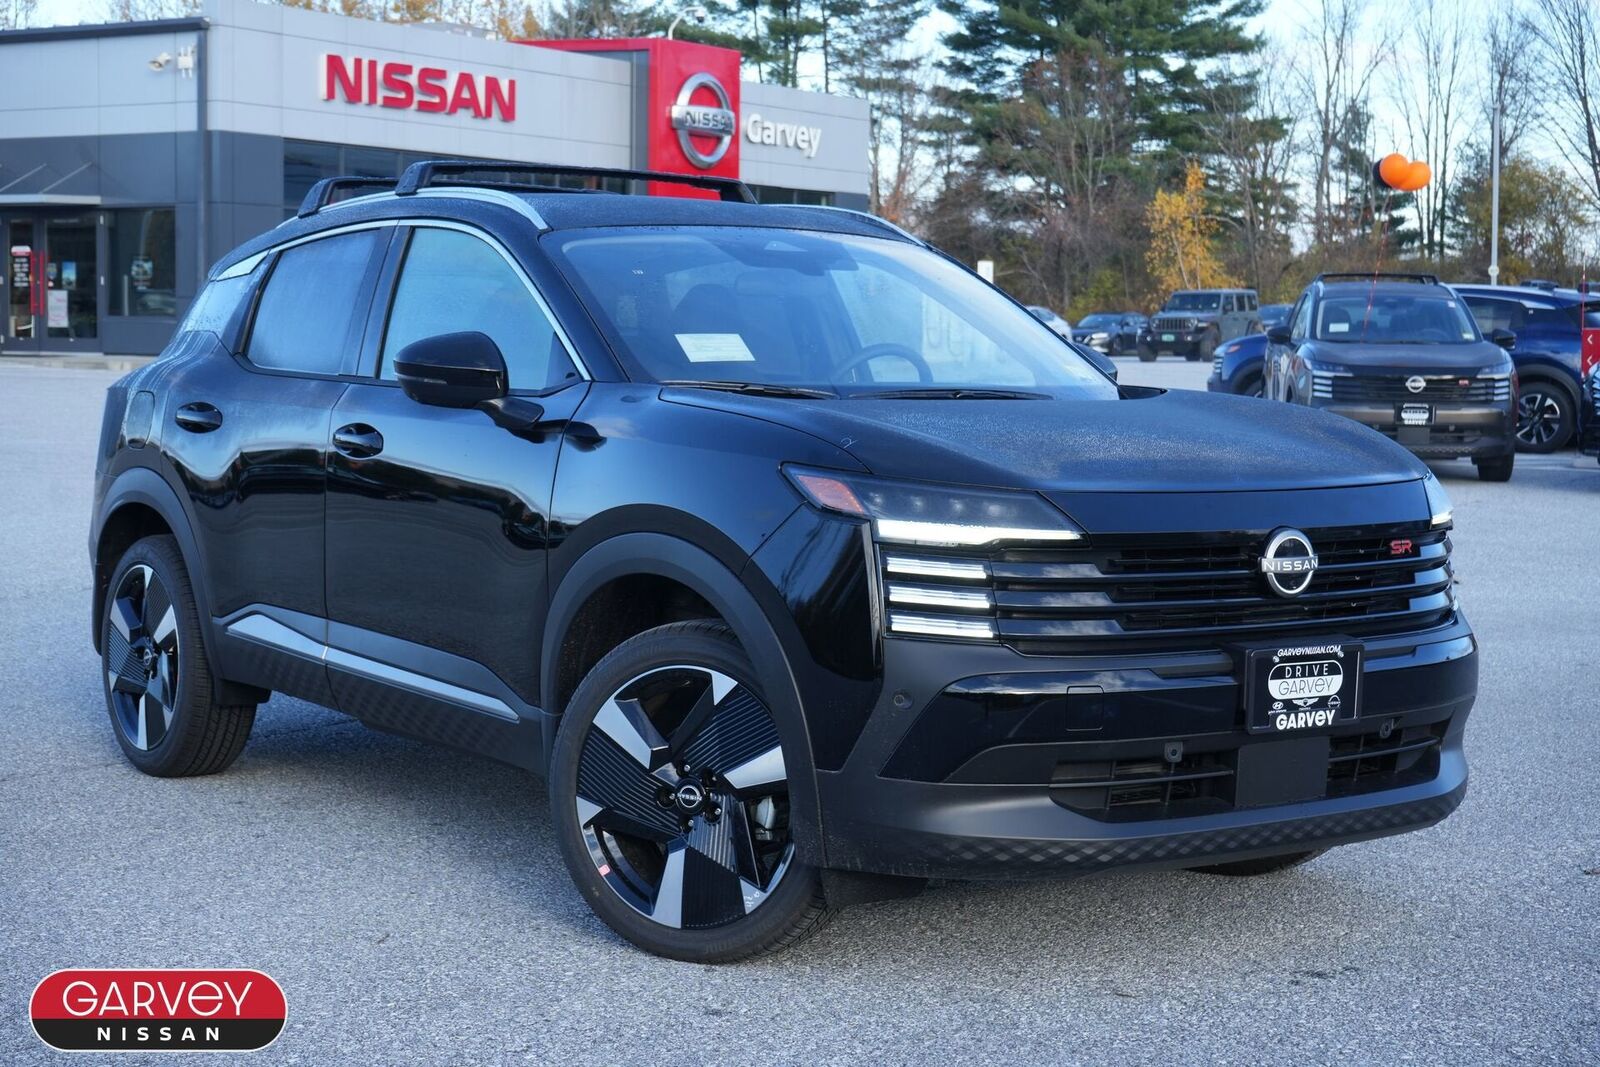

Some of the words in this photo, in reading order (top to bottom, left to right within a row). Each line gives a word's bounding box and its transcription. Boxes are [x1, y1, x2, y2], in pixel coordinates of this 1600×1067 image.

[324, 54, 516, 121] NISSAN
[745, 113, 822, 158] Garvey
[1390, 539, 1412, 554] SR
[1263, 558, 1318, 571] NISSAN
[1285, 664, 1329, 678] DRIVE
[1278, 677, 1334, 696] GARVEY
[1276, 709, 1336, 731] GARVEY
